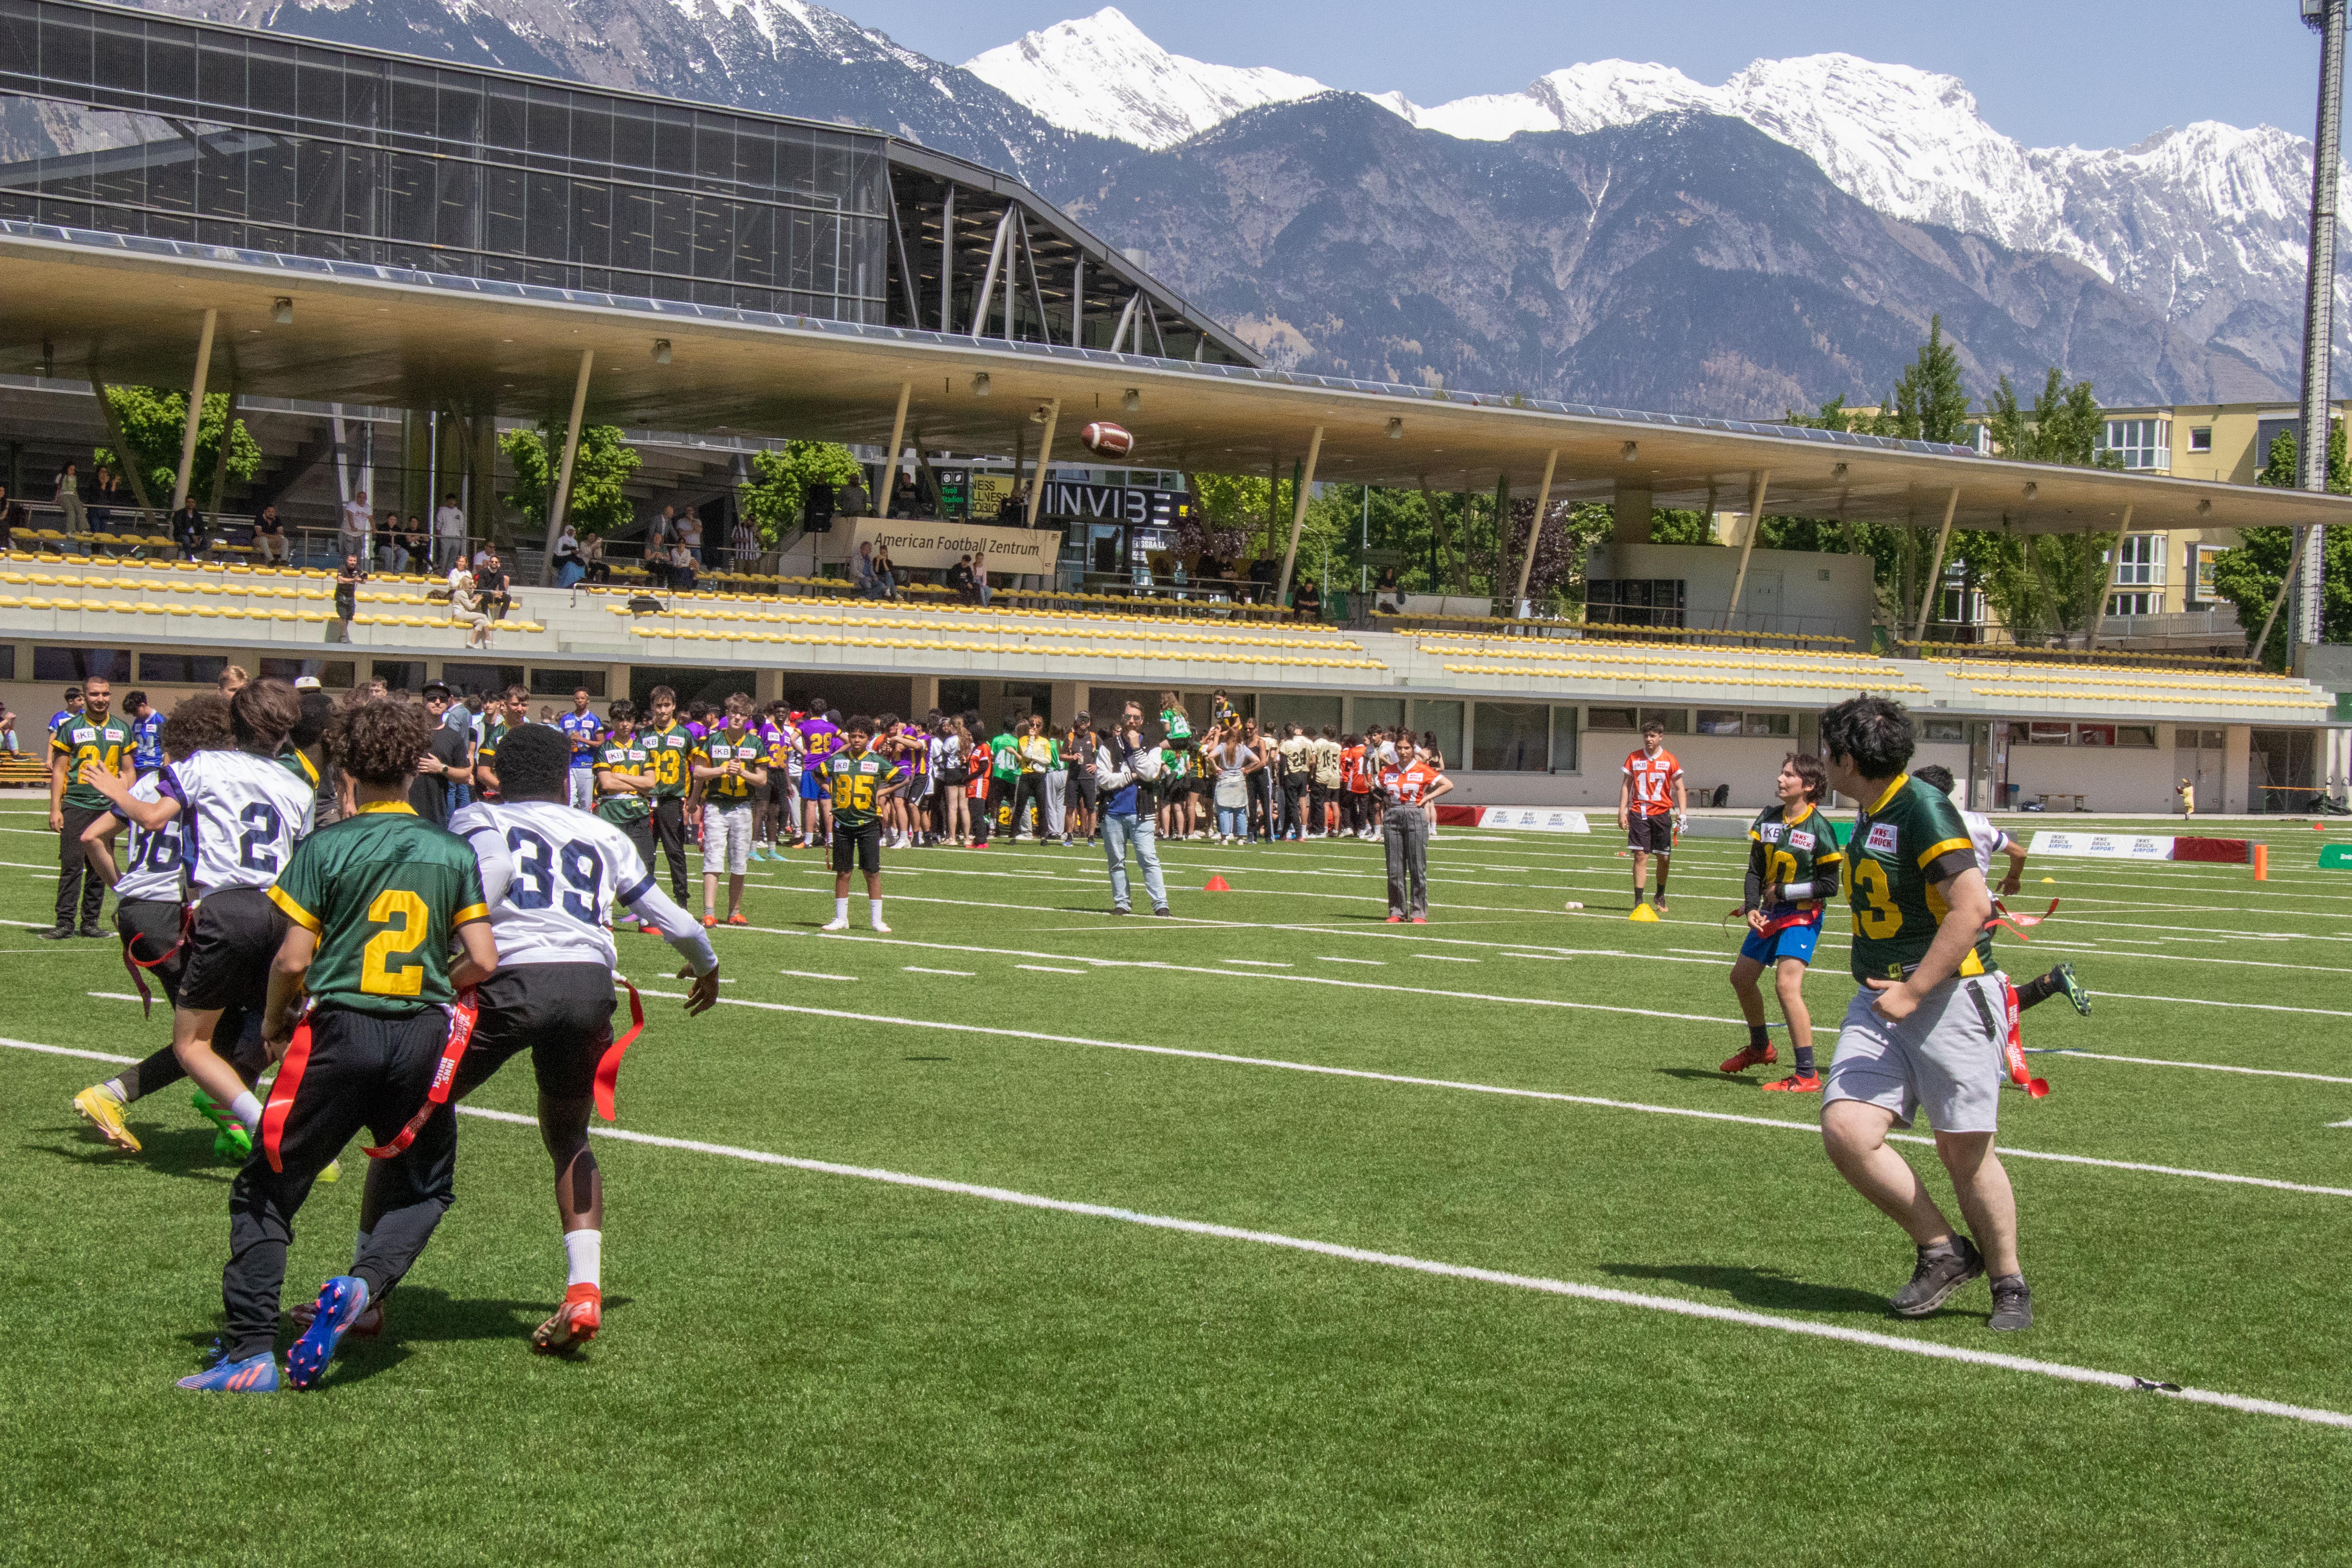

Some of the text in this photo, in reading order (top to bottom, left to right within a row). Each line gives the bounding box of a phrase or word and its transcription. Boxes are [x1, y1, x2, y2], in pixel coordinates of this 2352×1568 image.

[874, 533, 1039, 555] American Football Zentrum
[836, 774, 874, 809] 85
[1637, 772, 1666, 801] 17
[240, 802, 281, 875] 2
[1791, 838, 1811, 848] BRUCK
[1869, 836, 1893, 848] BRUCK
[506, 826, 603, 928] 39
[361, 889, 428, 996] 2
[431, 1057, 448, 1089] BRUCK
